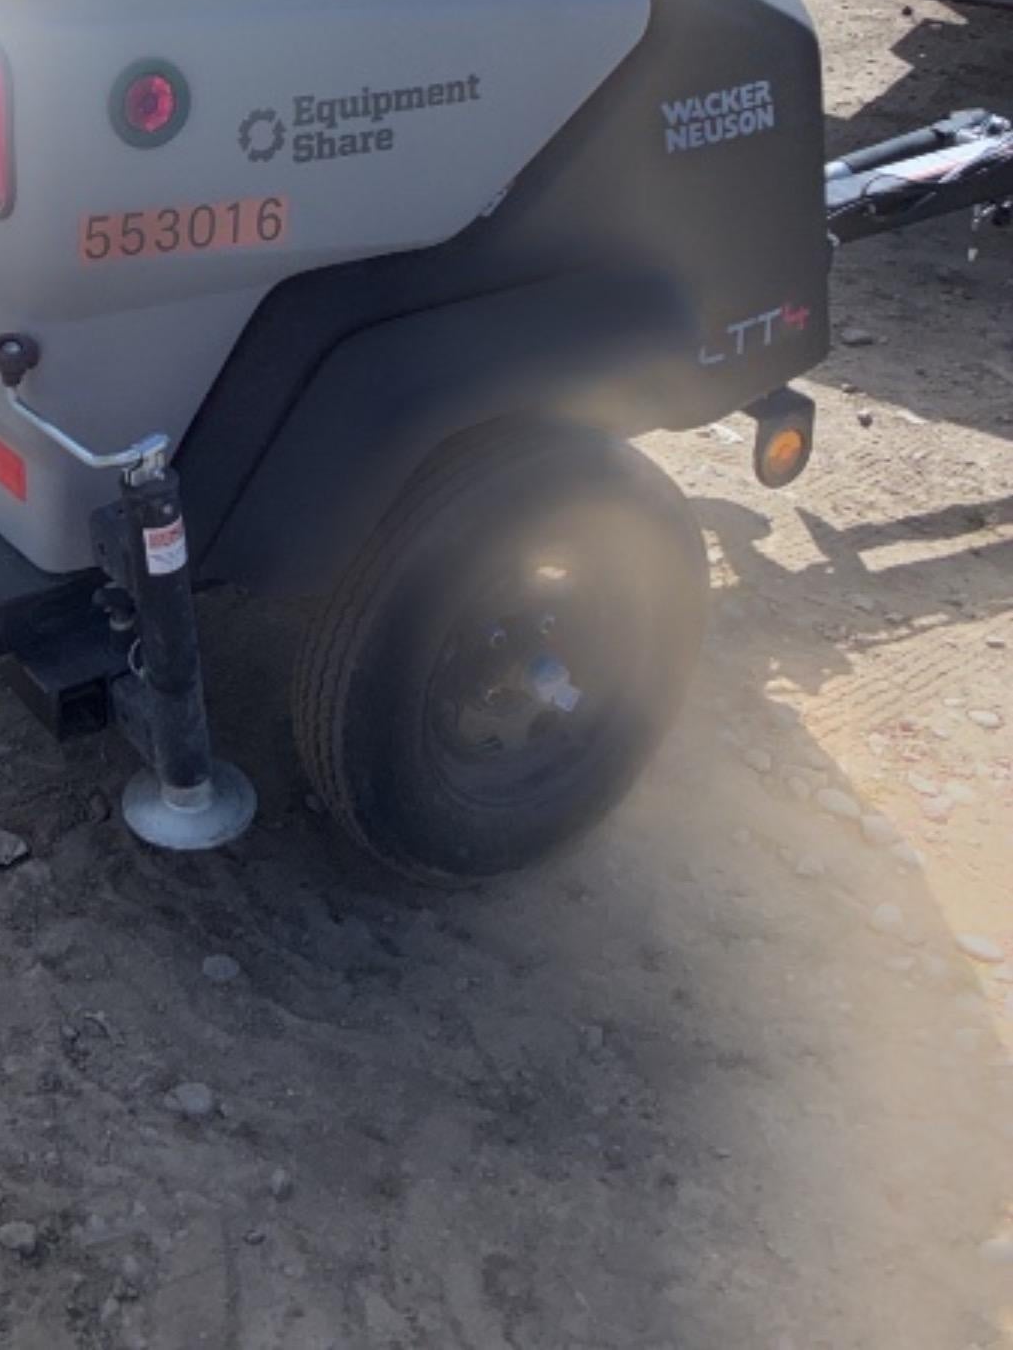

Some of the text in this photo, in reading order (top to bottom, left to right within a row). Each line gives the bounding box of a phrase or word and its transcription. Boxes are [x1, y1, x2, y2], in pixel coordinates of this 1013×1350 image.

[292, 73, 482, 130] Equipment
[661, 80, 773, 125] WACKER
[292, 127, 394, 164] Share
[665, 105, 775, 154] NEUSON
[85, 197, 283, 259] 553016
